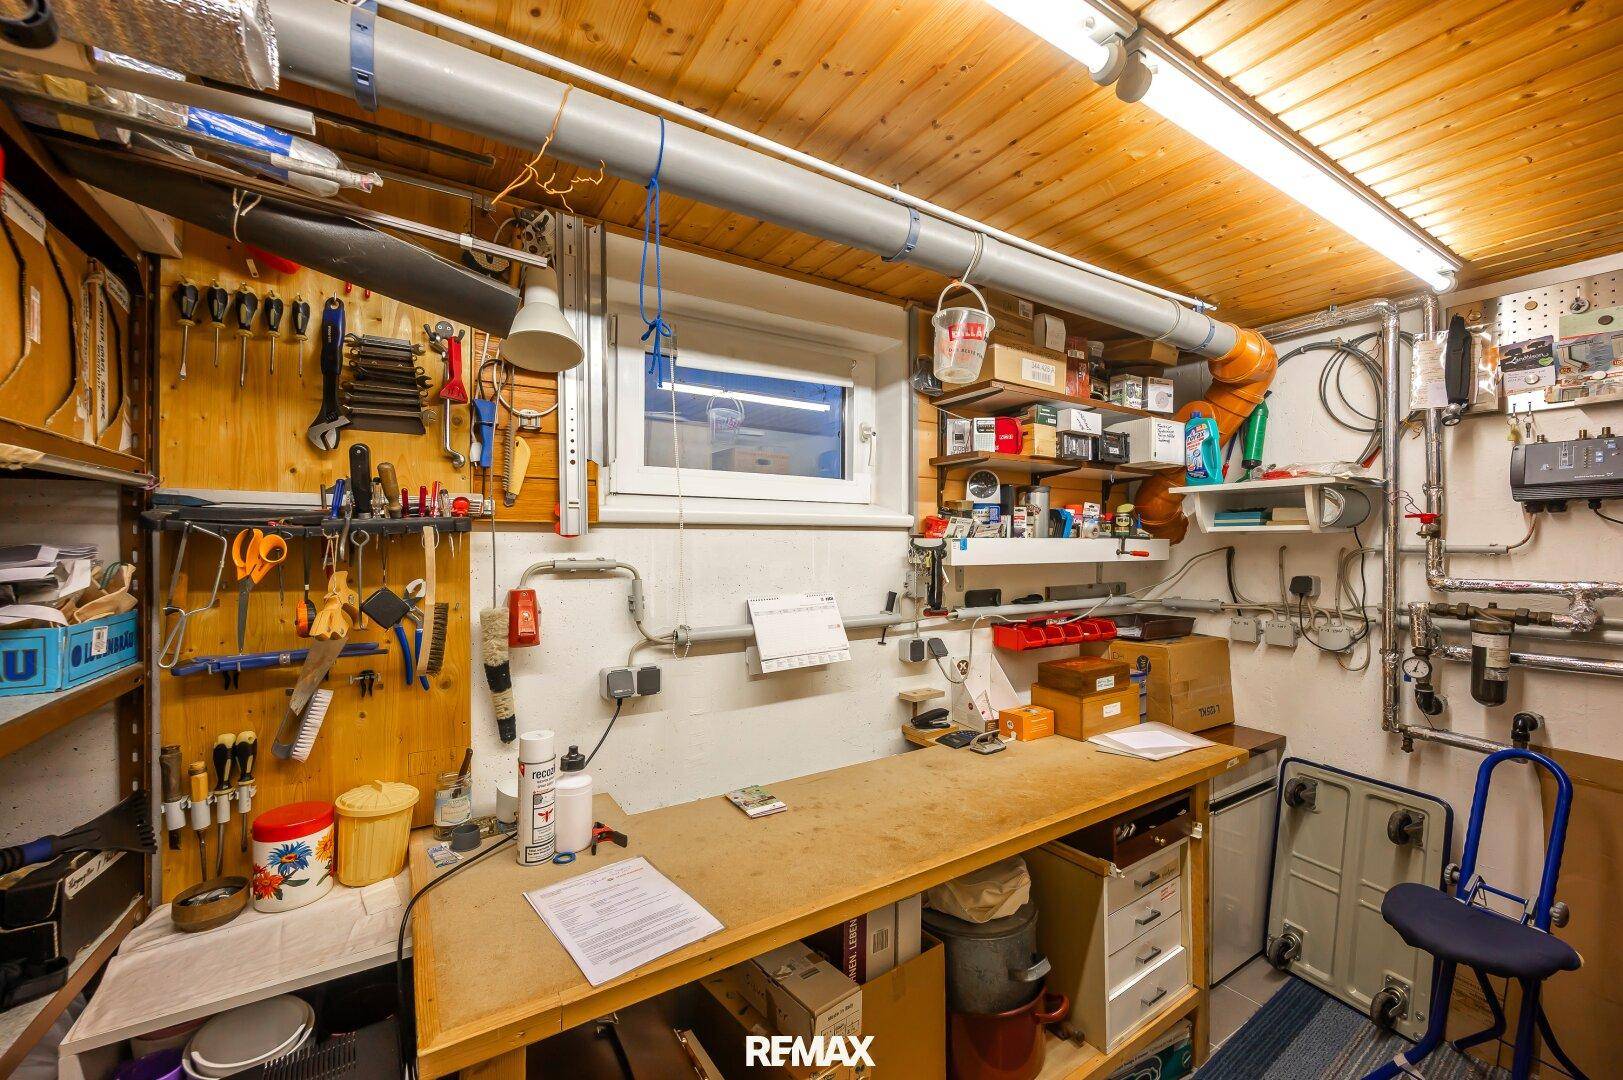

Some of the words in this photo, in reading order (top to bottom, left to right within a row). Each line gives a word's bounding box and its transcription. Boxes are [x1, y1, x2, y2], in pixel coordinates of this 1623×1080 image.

[84, 630, 135, 663] LNBRÄU
[0, 648, 39, 682] U
[848, 918, 858, 950] LEBEN
[827, 1011, 839, 1022] Made
